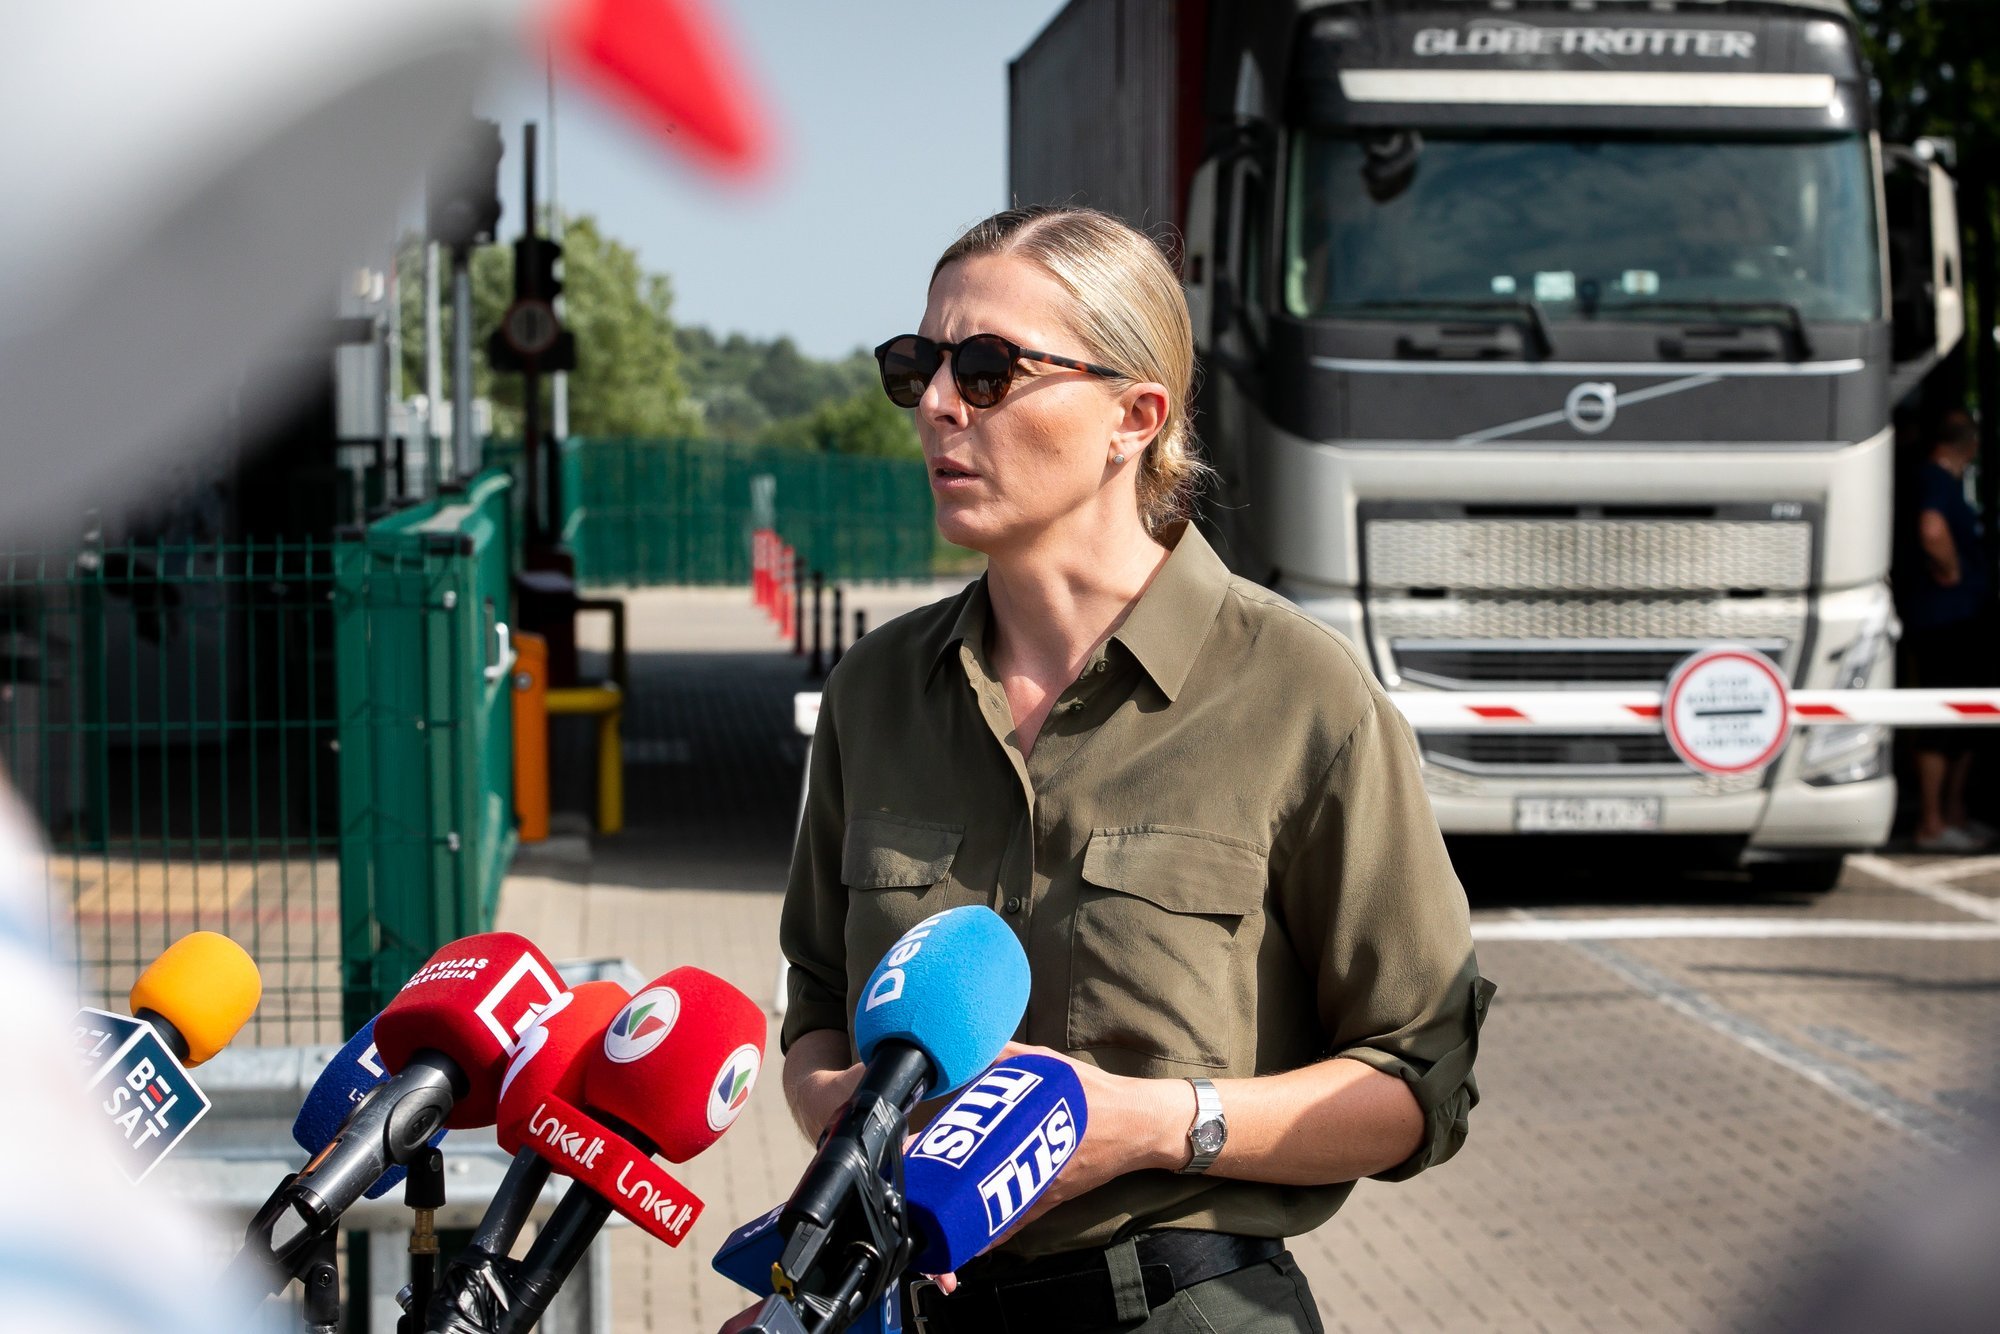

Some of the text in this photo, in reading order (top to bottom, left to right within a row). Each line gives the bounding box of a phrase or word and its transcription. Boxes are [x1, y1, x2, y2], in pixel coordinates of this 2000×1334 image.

[409, 957, 489, 982] LATVIJAS
[102, 1085, 161, 1150] SAT
[125, 1056, 179, 1130] BEL
[979, 1103, 1076, 1228] TTS
